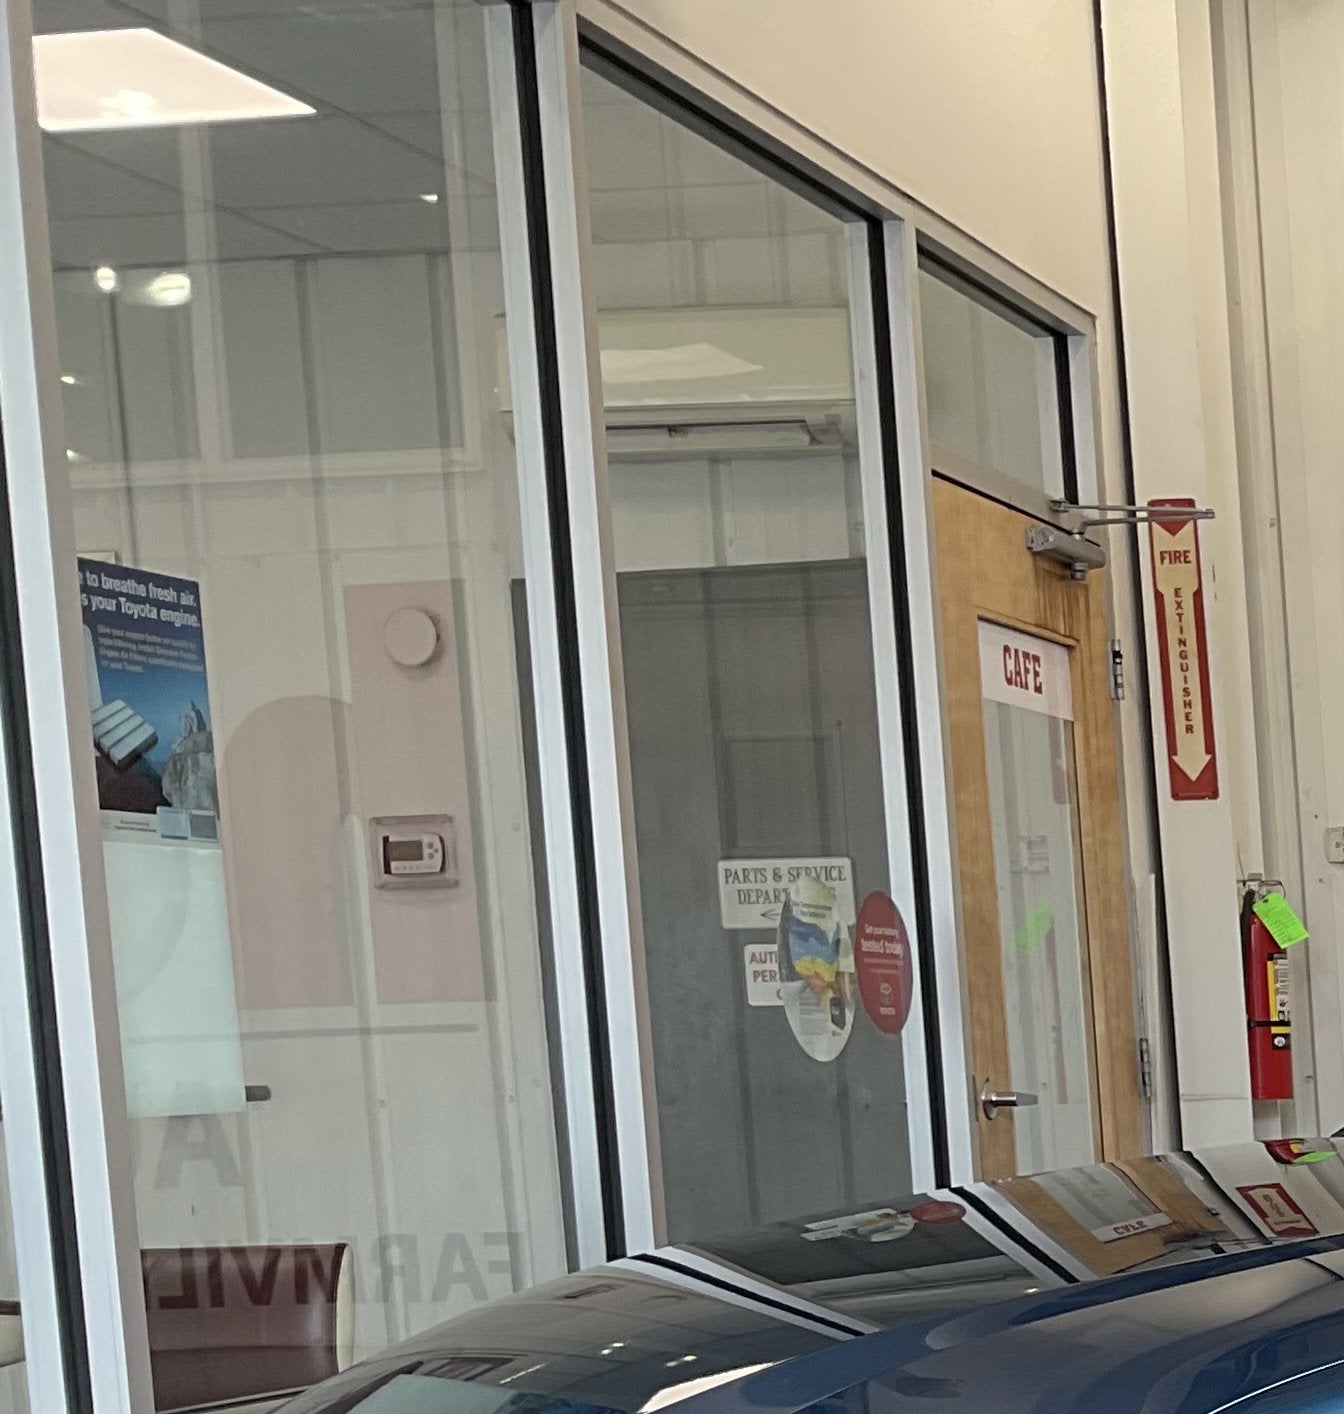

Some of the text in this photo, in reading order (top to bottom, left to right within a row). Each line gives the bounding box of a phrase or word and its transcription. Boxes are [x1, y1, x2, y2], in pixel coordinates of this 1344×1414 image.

[1159, 550, 1192, 565] FIRE
[85, 570, 99, 588] to
[100, 572, 147, 597] breathe
[148, 581, 178, 603] fresh
[180, 589, 197, 607] air.
[89, 595, 117, 612] your
[118, 597, 158, 619] Toyota
[160, 608, 201, 627] engine.
[1003, 644, 1043, 695] CAFE
[1173, 587, 1194, 735] EXTINGUISHER
[724, 865, 847, 885] PARTS & SERVICE
